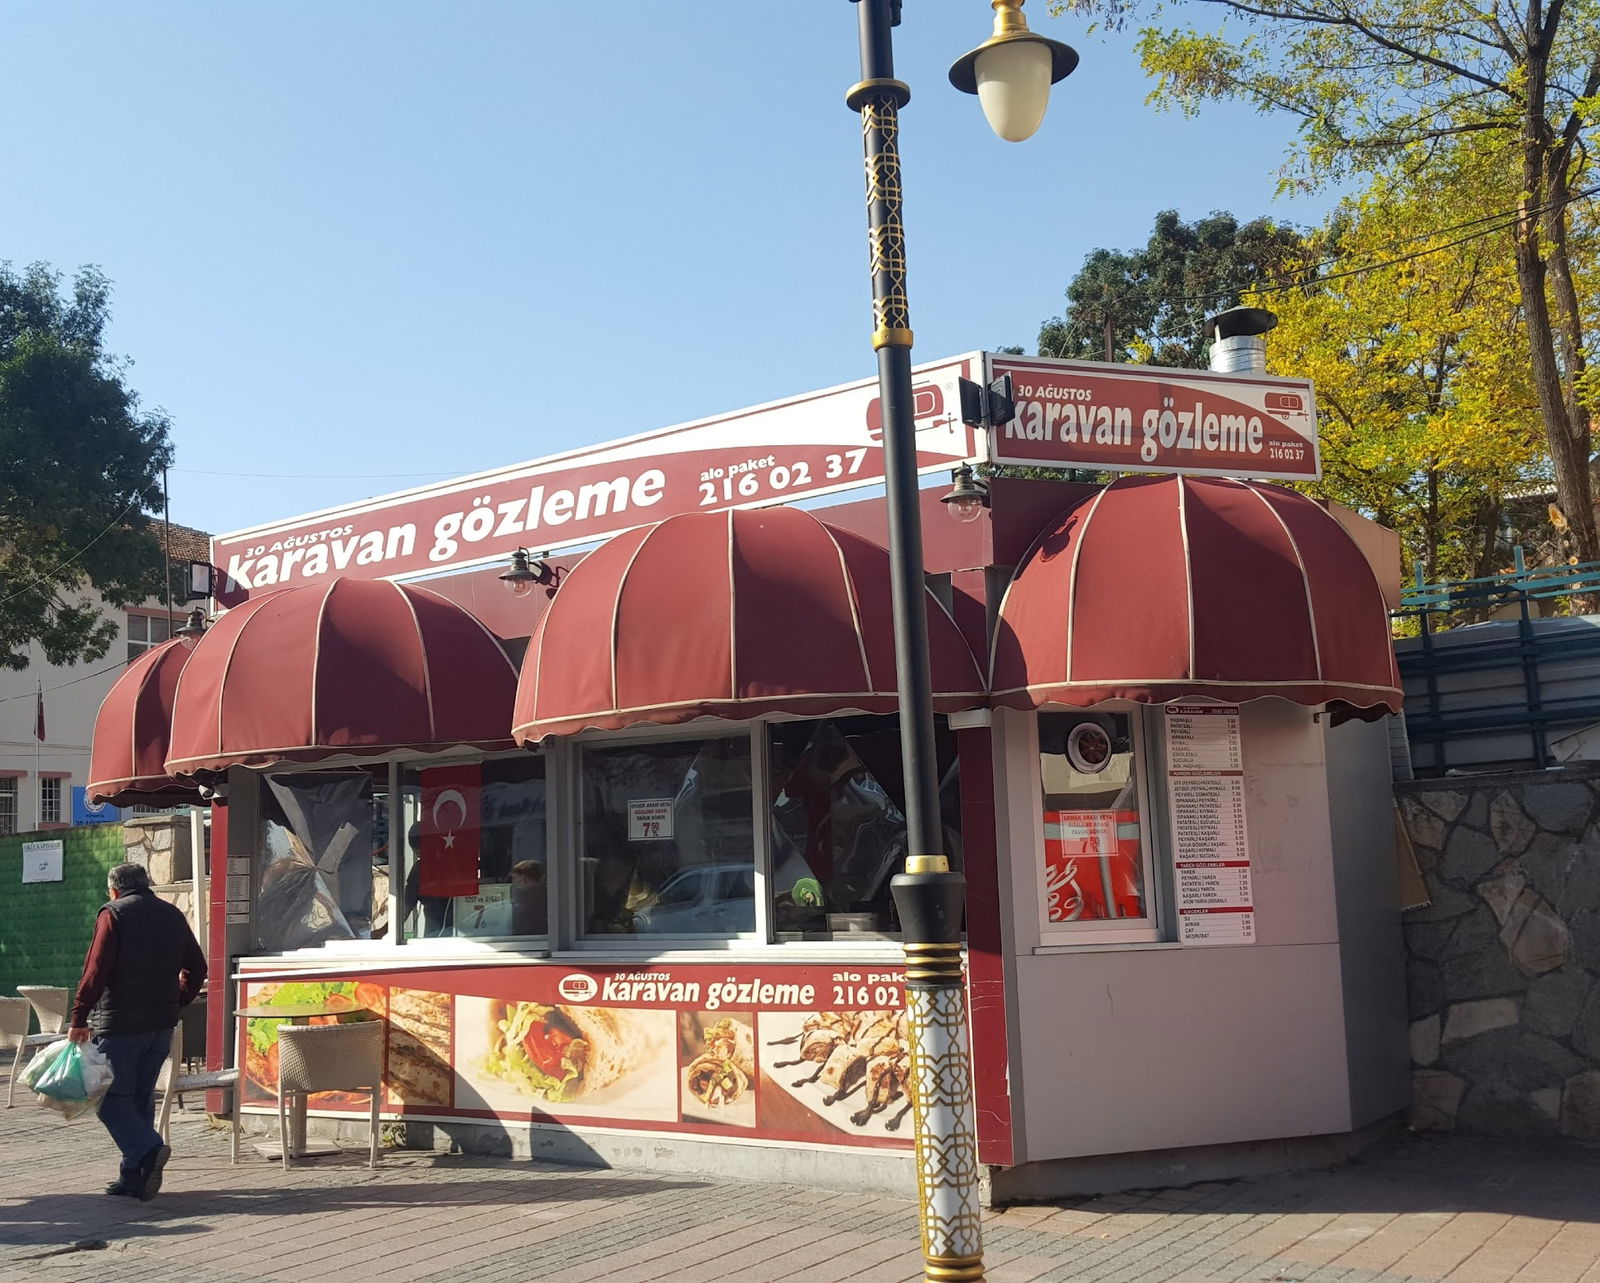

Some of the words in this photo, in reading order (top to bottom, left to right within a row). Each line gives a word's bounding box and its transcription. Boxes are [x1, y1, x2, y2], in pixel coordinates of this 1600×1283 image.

[1018, 384, 1033, 397] 30
[1035, 383, 1093, 402] AĞUSTOS
[1005, 400, 1133, 447] karavan
[1140, 396, 1263, 462] gözleme
[1270, 447, 1283, 460] 216
[1284, 448, 1294, 460] 02
[1296, 449, 1304, 461] 37
[698, 473, 760, 506] 216
[769, 461, 812, 490] 02
[825, 447, 868, 479] 37
[700, 468, 725, 482] alo
[728, 454, 777, 479] paket
[224, 521, 417, 594] karavan
[427, 468, 666, 563] gözleme
[244, 544, 265, 559] 30
[268, 524, 354, 554] AĞUSTOS
[643, 823, 650, 836] 7
[614, 973, 625, 981] 30
[627, 972, 671, 982] AĞUSTOS
[832, 972, 862, 982] alo
[867, 972, 908, 985] pak
[601, 977, 700, 1003] karavan
[705, 977, 815, 1010] gözleme
[832, 985, 870, 1005] 216
[874, 986, 900, 1006] 02
